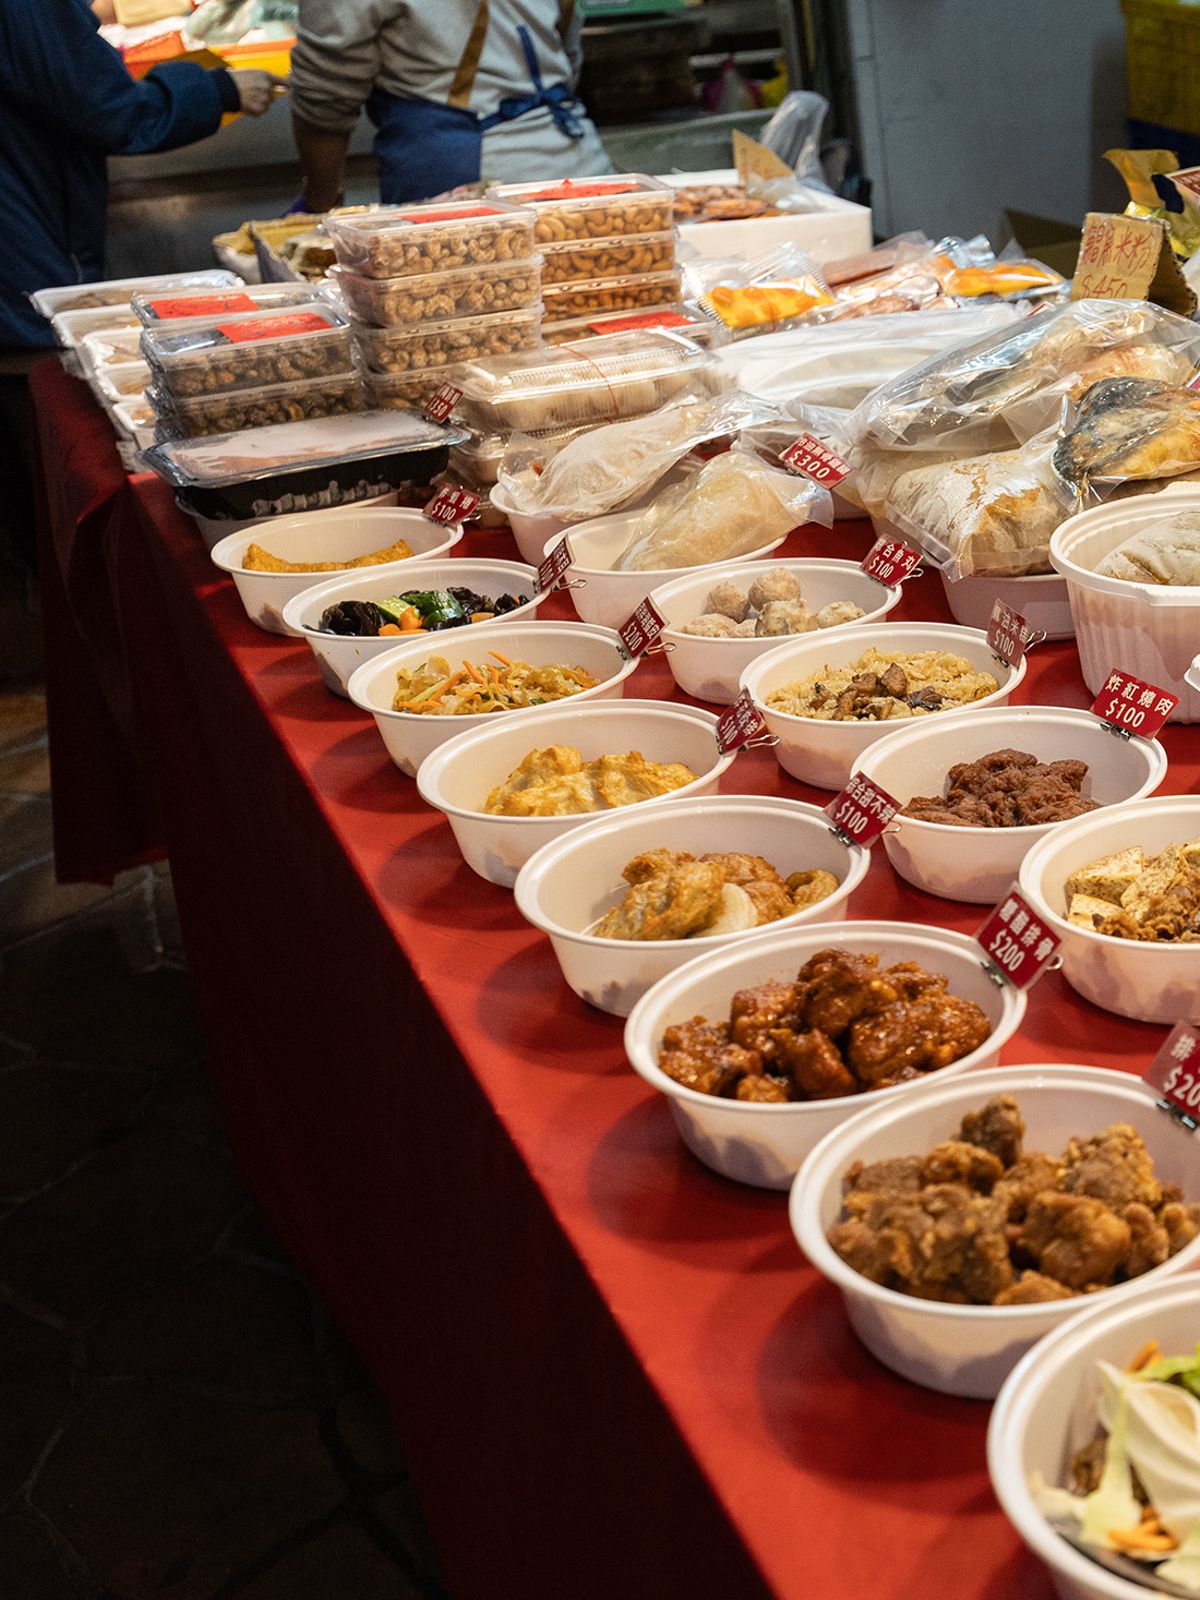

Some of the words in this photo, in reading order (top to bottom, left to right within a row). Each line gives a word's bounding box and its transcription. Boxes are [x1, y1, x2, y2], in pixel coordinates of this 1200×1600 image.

[788, 450, 831, 479] $300
[431, 502, 457, 521] $100
[868, 556, 895, 578] $100
[622, 620, 644, 652] $200
[993, 628, 1015, 657] $100
[1104, 674, 1174, 717] 炸紅燒肉
[1104, 698, 1146, 728] $100
[720, 715, 739, 745] $100
[834, 800, 869, 834] $100
[988, 928, 1026, 972] $200
